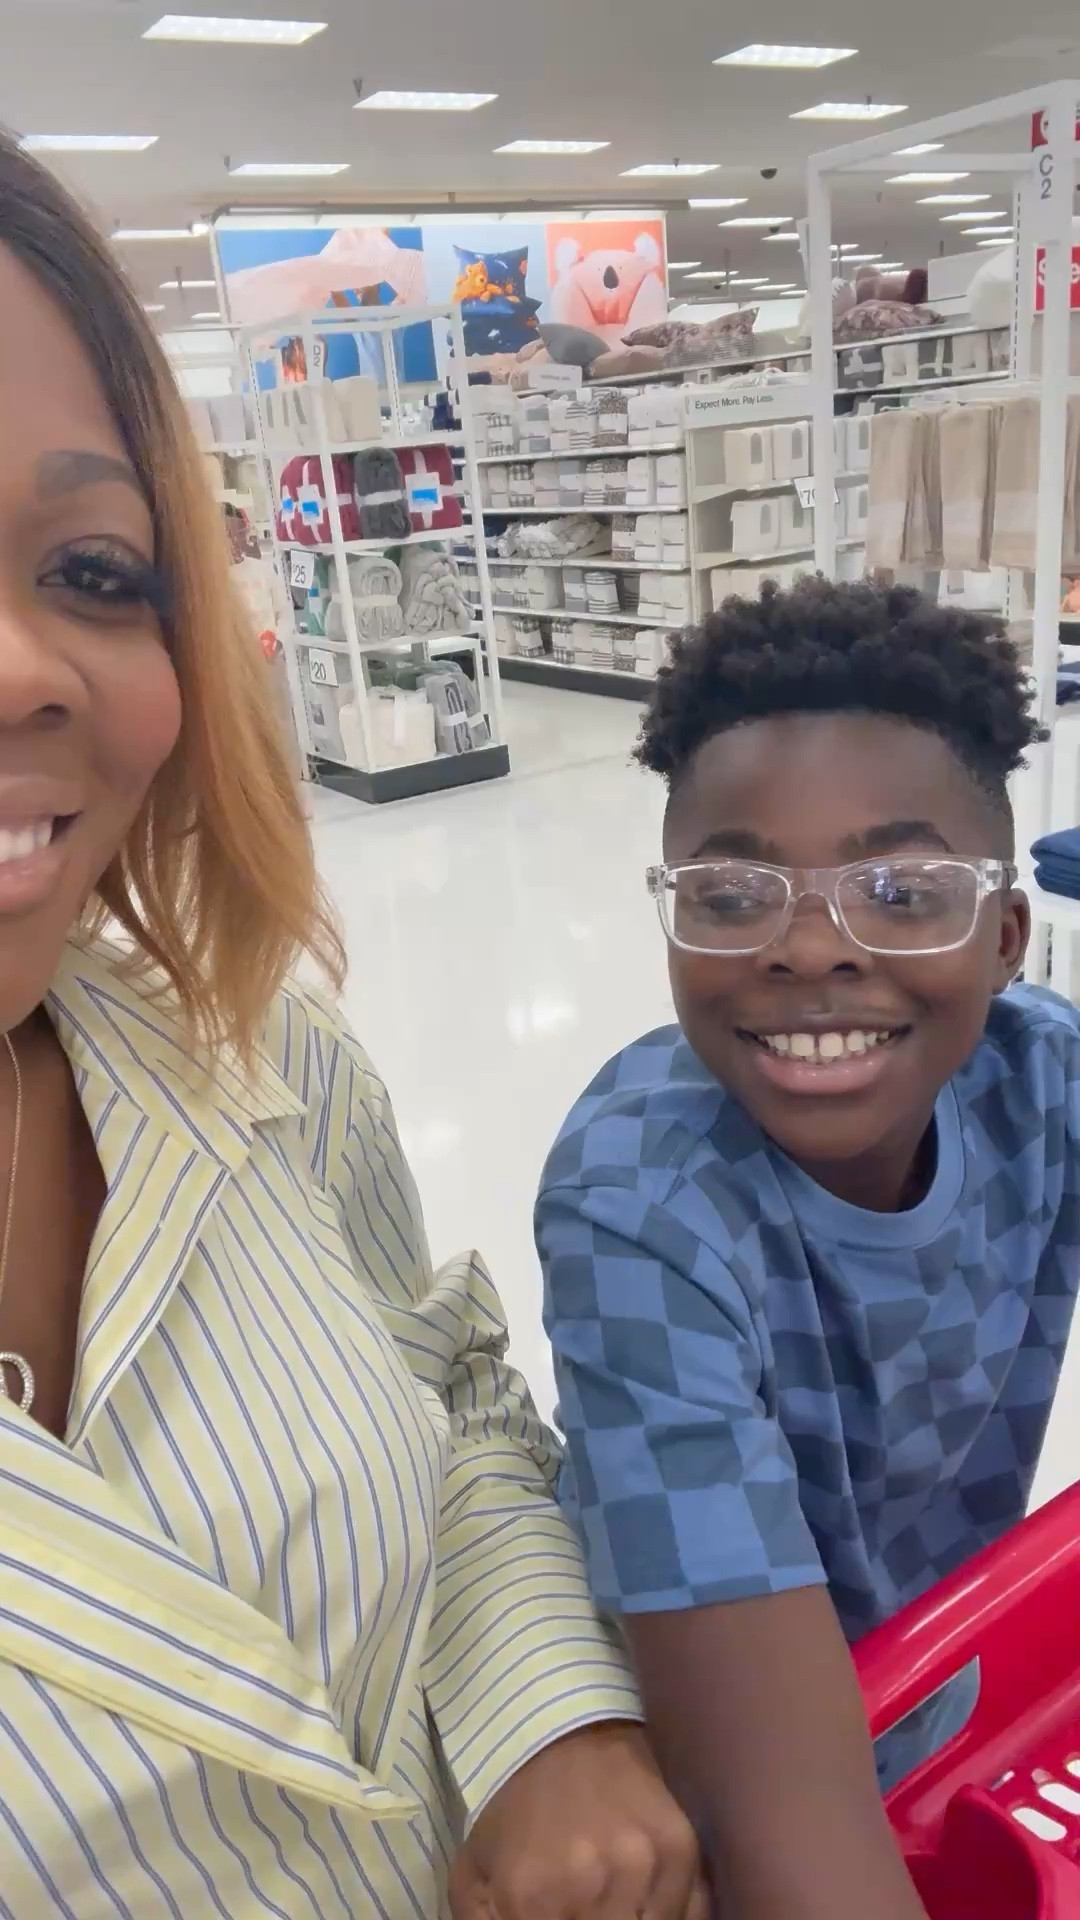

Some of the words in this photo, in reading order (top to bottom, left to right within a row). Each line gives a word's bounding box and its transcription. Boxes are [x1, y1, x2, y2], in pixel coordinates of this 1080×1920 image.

[1039, 153, 1053, 176] C
[1041, 177, 1052, 200] 2
[694, 399, 720, 411] Expect
[742, 395, 755, 405] Pay
